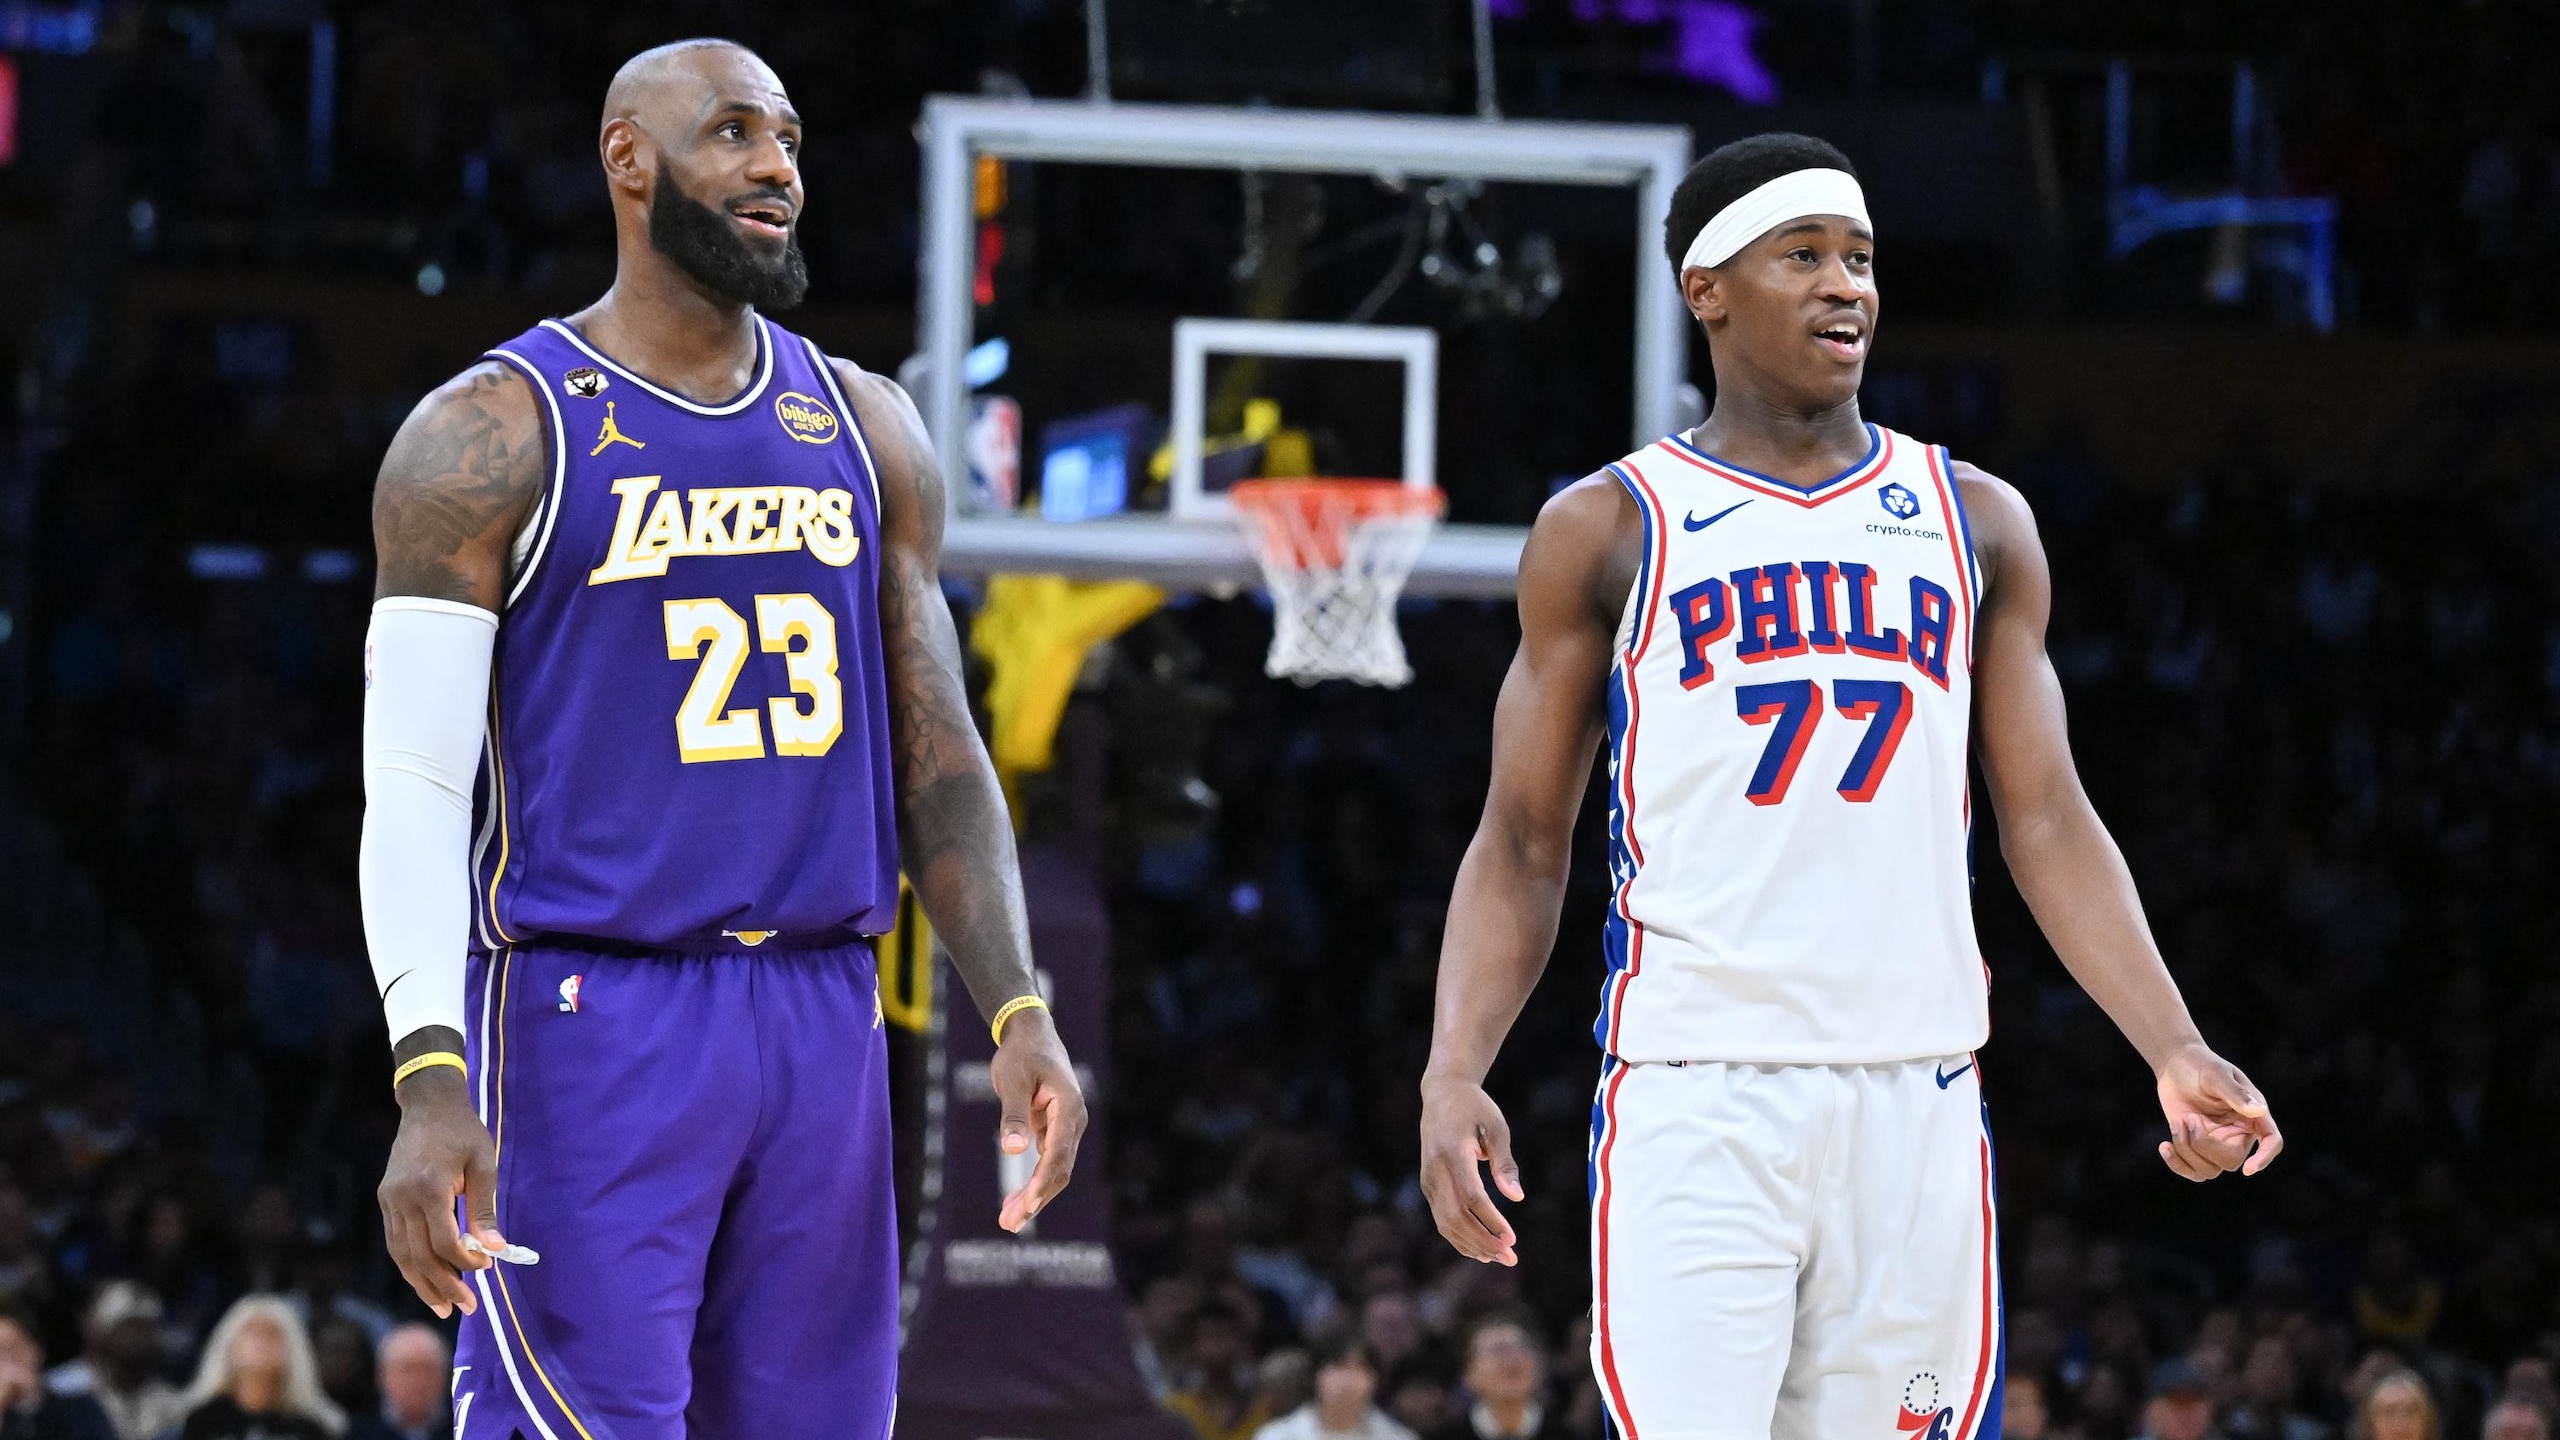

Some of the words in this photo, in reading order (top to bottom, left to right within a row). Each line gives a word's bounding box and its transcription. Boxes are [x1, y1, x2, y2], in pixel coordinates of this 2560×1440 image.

[780, 403, 834, 431] bibigo
[588, 475, 861, 586] LAKERS
[1865, 523, 1943, 541] crypto.com
[663, 593, 844, 764] 23
[1669, 560, 1957, 693] PHILA
[1735, 679, 1914, 807] 77
[996, 998, 1031, 1025] PROMISE
